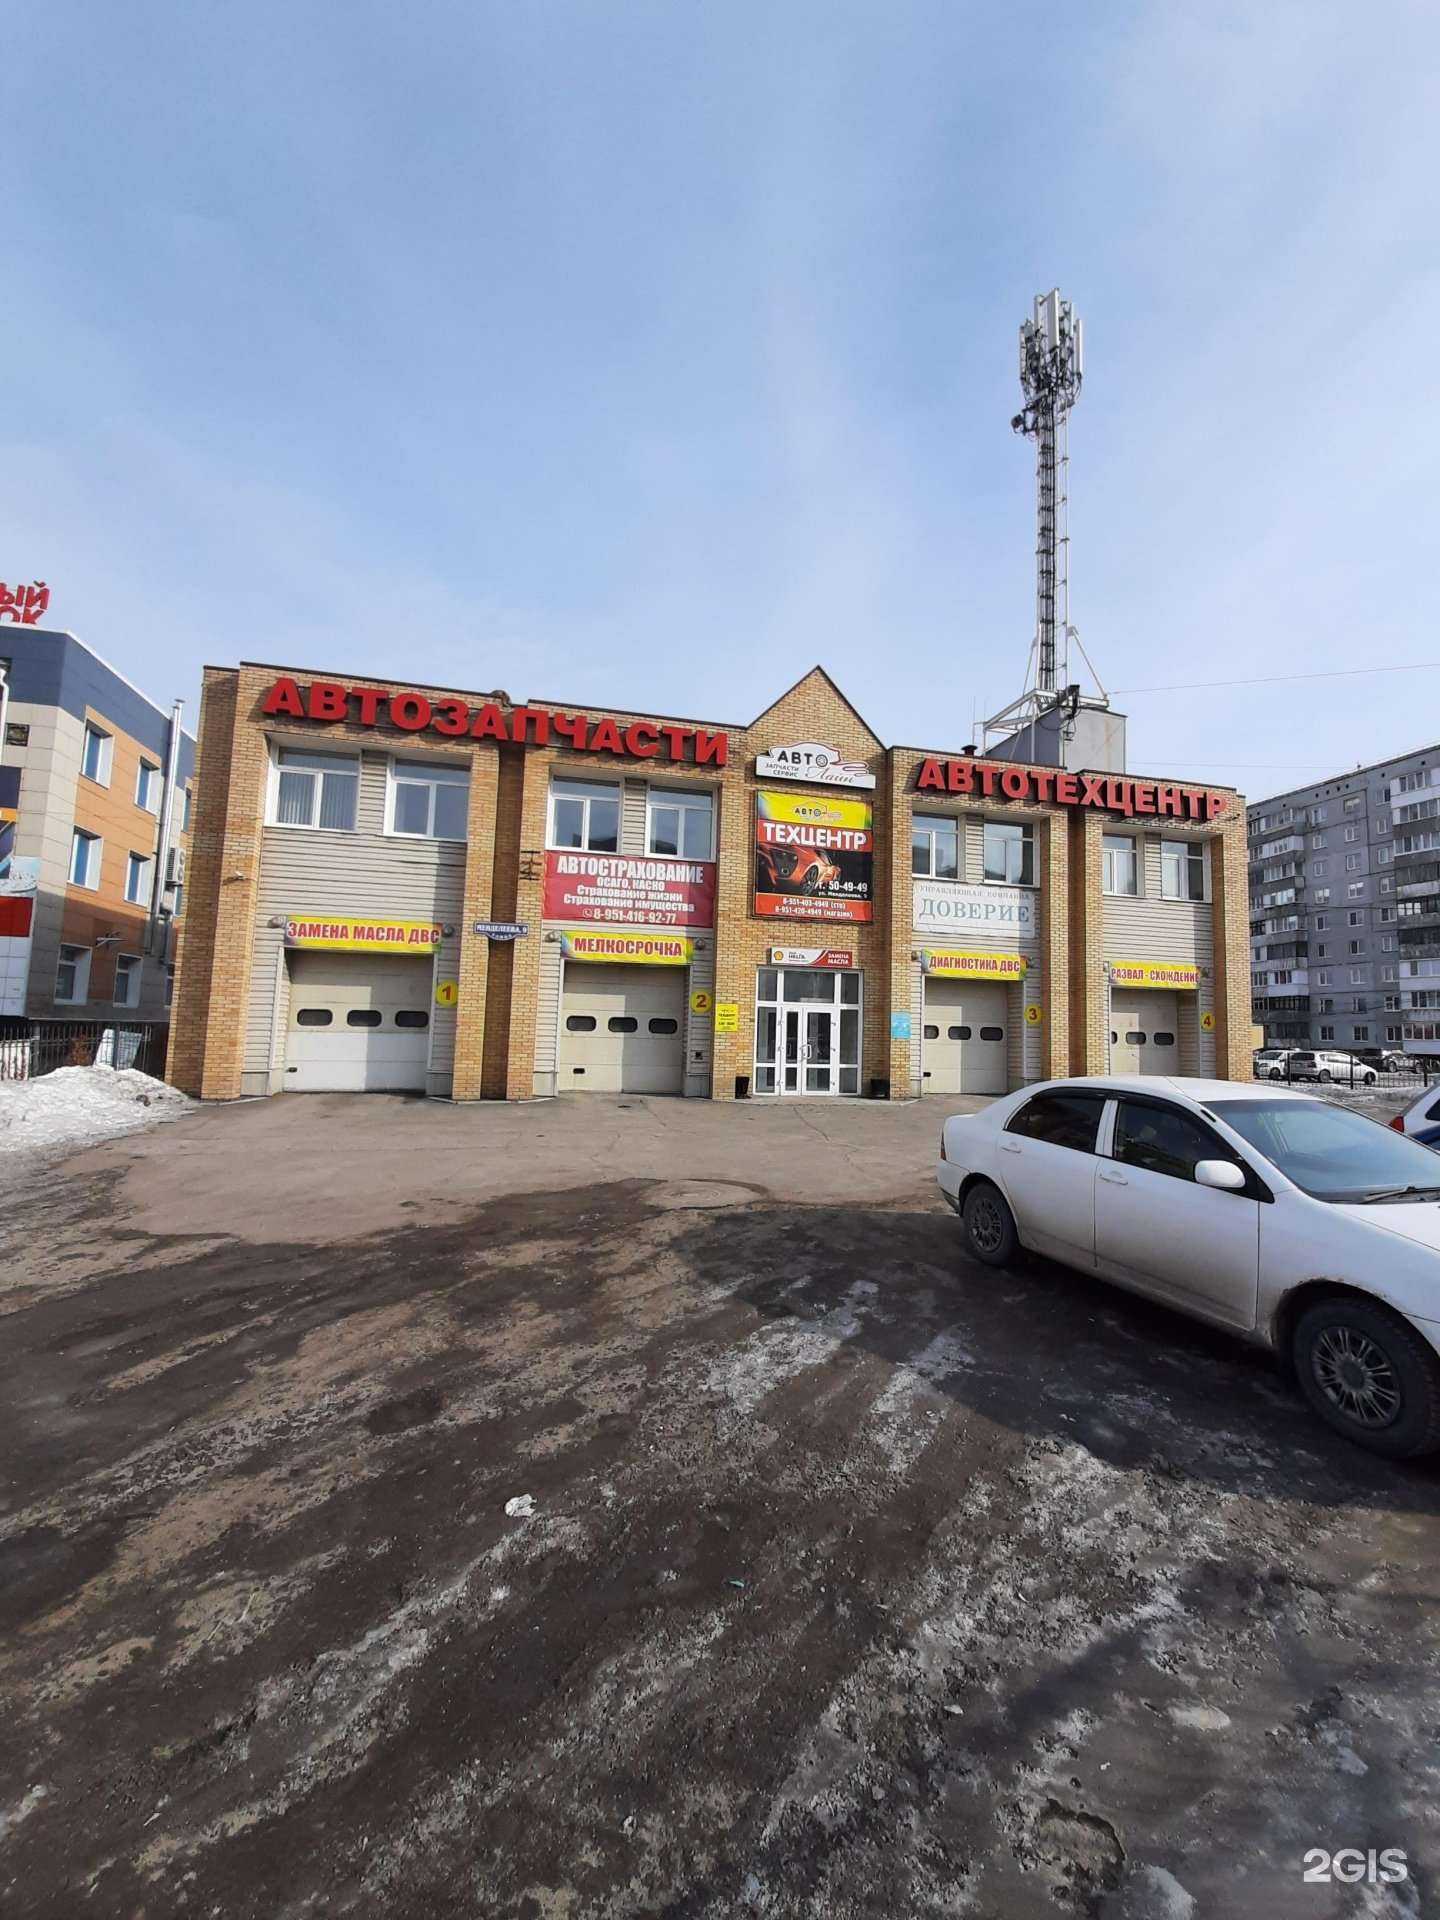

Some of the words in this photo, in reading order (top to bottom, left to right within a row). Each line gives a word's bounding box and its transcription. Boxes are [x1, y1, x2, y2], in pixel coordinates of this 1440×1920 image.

[262, 677, 727, 765] АВТОЗАПЧАСТИ
[765, 763, 799, 771] ЗАПЧАСТИ
[778, 750, 828, 767] АВТО
[773, 769, 799, 778] СЕРВИС
[917, 757, 1228, 820] АВТОТЕХЦЕНТР
[763, 822, 867, 850] ТЕХЦЕНТР
[557, 855, 704, 884] АВТОСТРАХОВАНИЕ
[577, 885, 645, 899] Страхование
[648, 891, 683, 902] жизни
[633, 880, 665, 891] КАСКО
[828, 881, 868, 892] 50-49-49
[564, 893, 633, 907] Страхование
[634, 900, 695, 912] имущества
[919, 898, 1030, 922] ДОВЕРИЕ
[593, 909, 676, 923] 8-951-416-92-77
[288, 922, 349, 939] ЗАМЕНА
[353, 926, 405, 941] МАСЛА
[408, 927, 441, 945] ДВС
[574, 937, 683, 957] МЕЛКОСРОЧКА
[929, 956, 998, 970] ДИАГНОСТИКА
[999, 960, 1020, 973] ДВС
[1111, 968, 1144, 980] РАЗВАЛ
[1150, 970, 1199, 983] СХОЖДЕНИЕ
[442, 985, 452, 1000] 1
[696, 994, 707, 1008] 2
[1028, 1007, 1038, 1021] 3
[1203, 1015, 1212, 1027] 4
